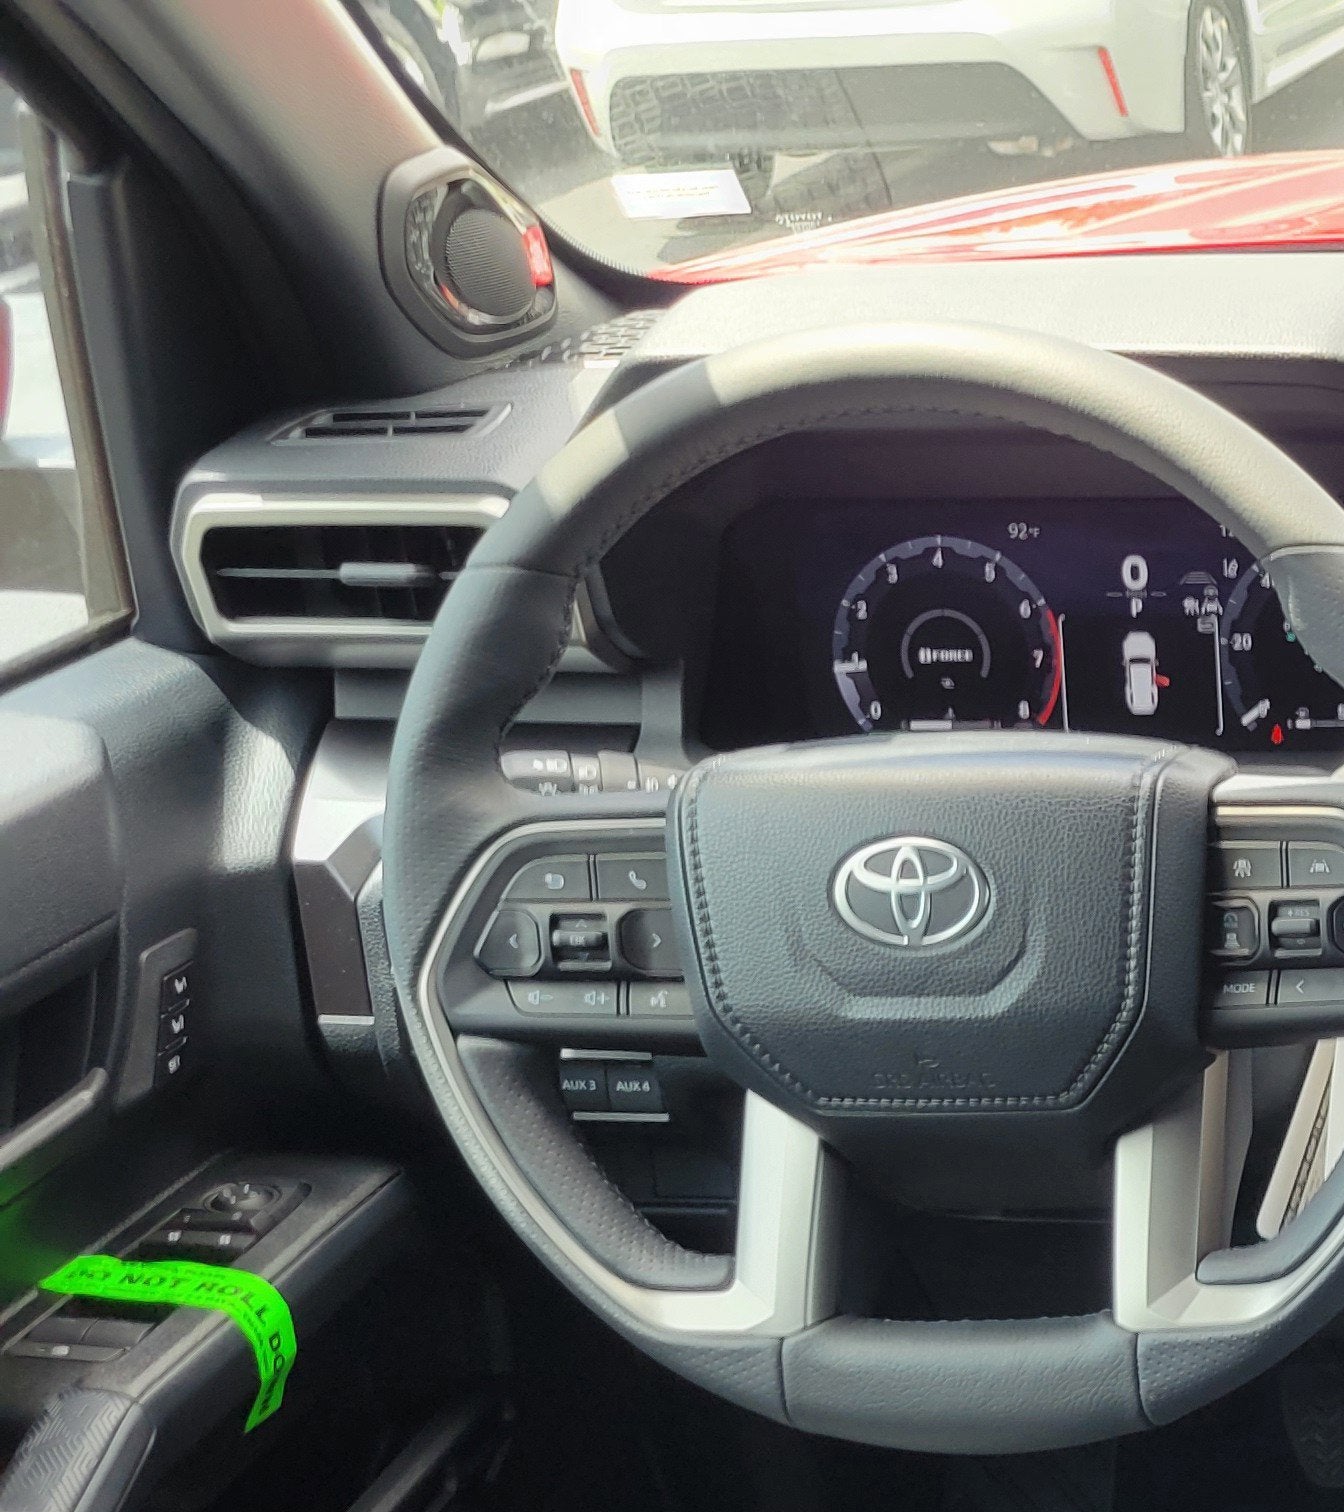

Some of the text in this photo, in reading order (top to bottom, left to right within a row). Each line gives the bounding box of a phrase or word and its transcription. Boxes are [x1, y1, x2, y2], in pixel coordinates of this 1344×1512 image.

[932, 548, 943, 568] 4
[1121, 554, 1148, 591] 0
[856, 600, 868, 620] 2
[1019, 599, 1031, 619] 6
[1231, 633, 1252, 652] 20
[1033, 650, 1044, 669] 7
[870, 700, 882, 720] 0
[1222, 983, 1256, 994] MODE
[562, 1078, 587, 1091] AUX
[616, 1080, 640, 1092] AUX
